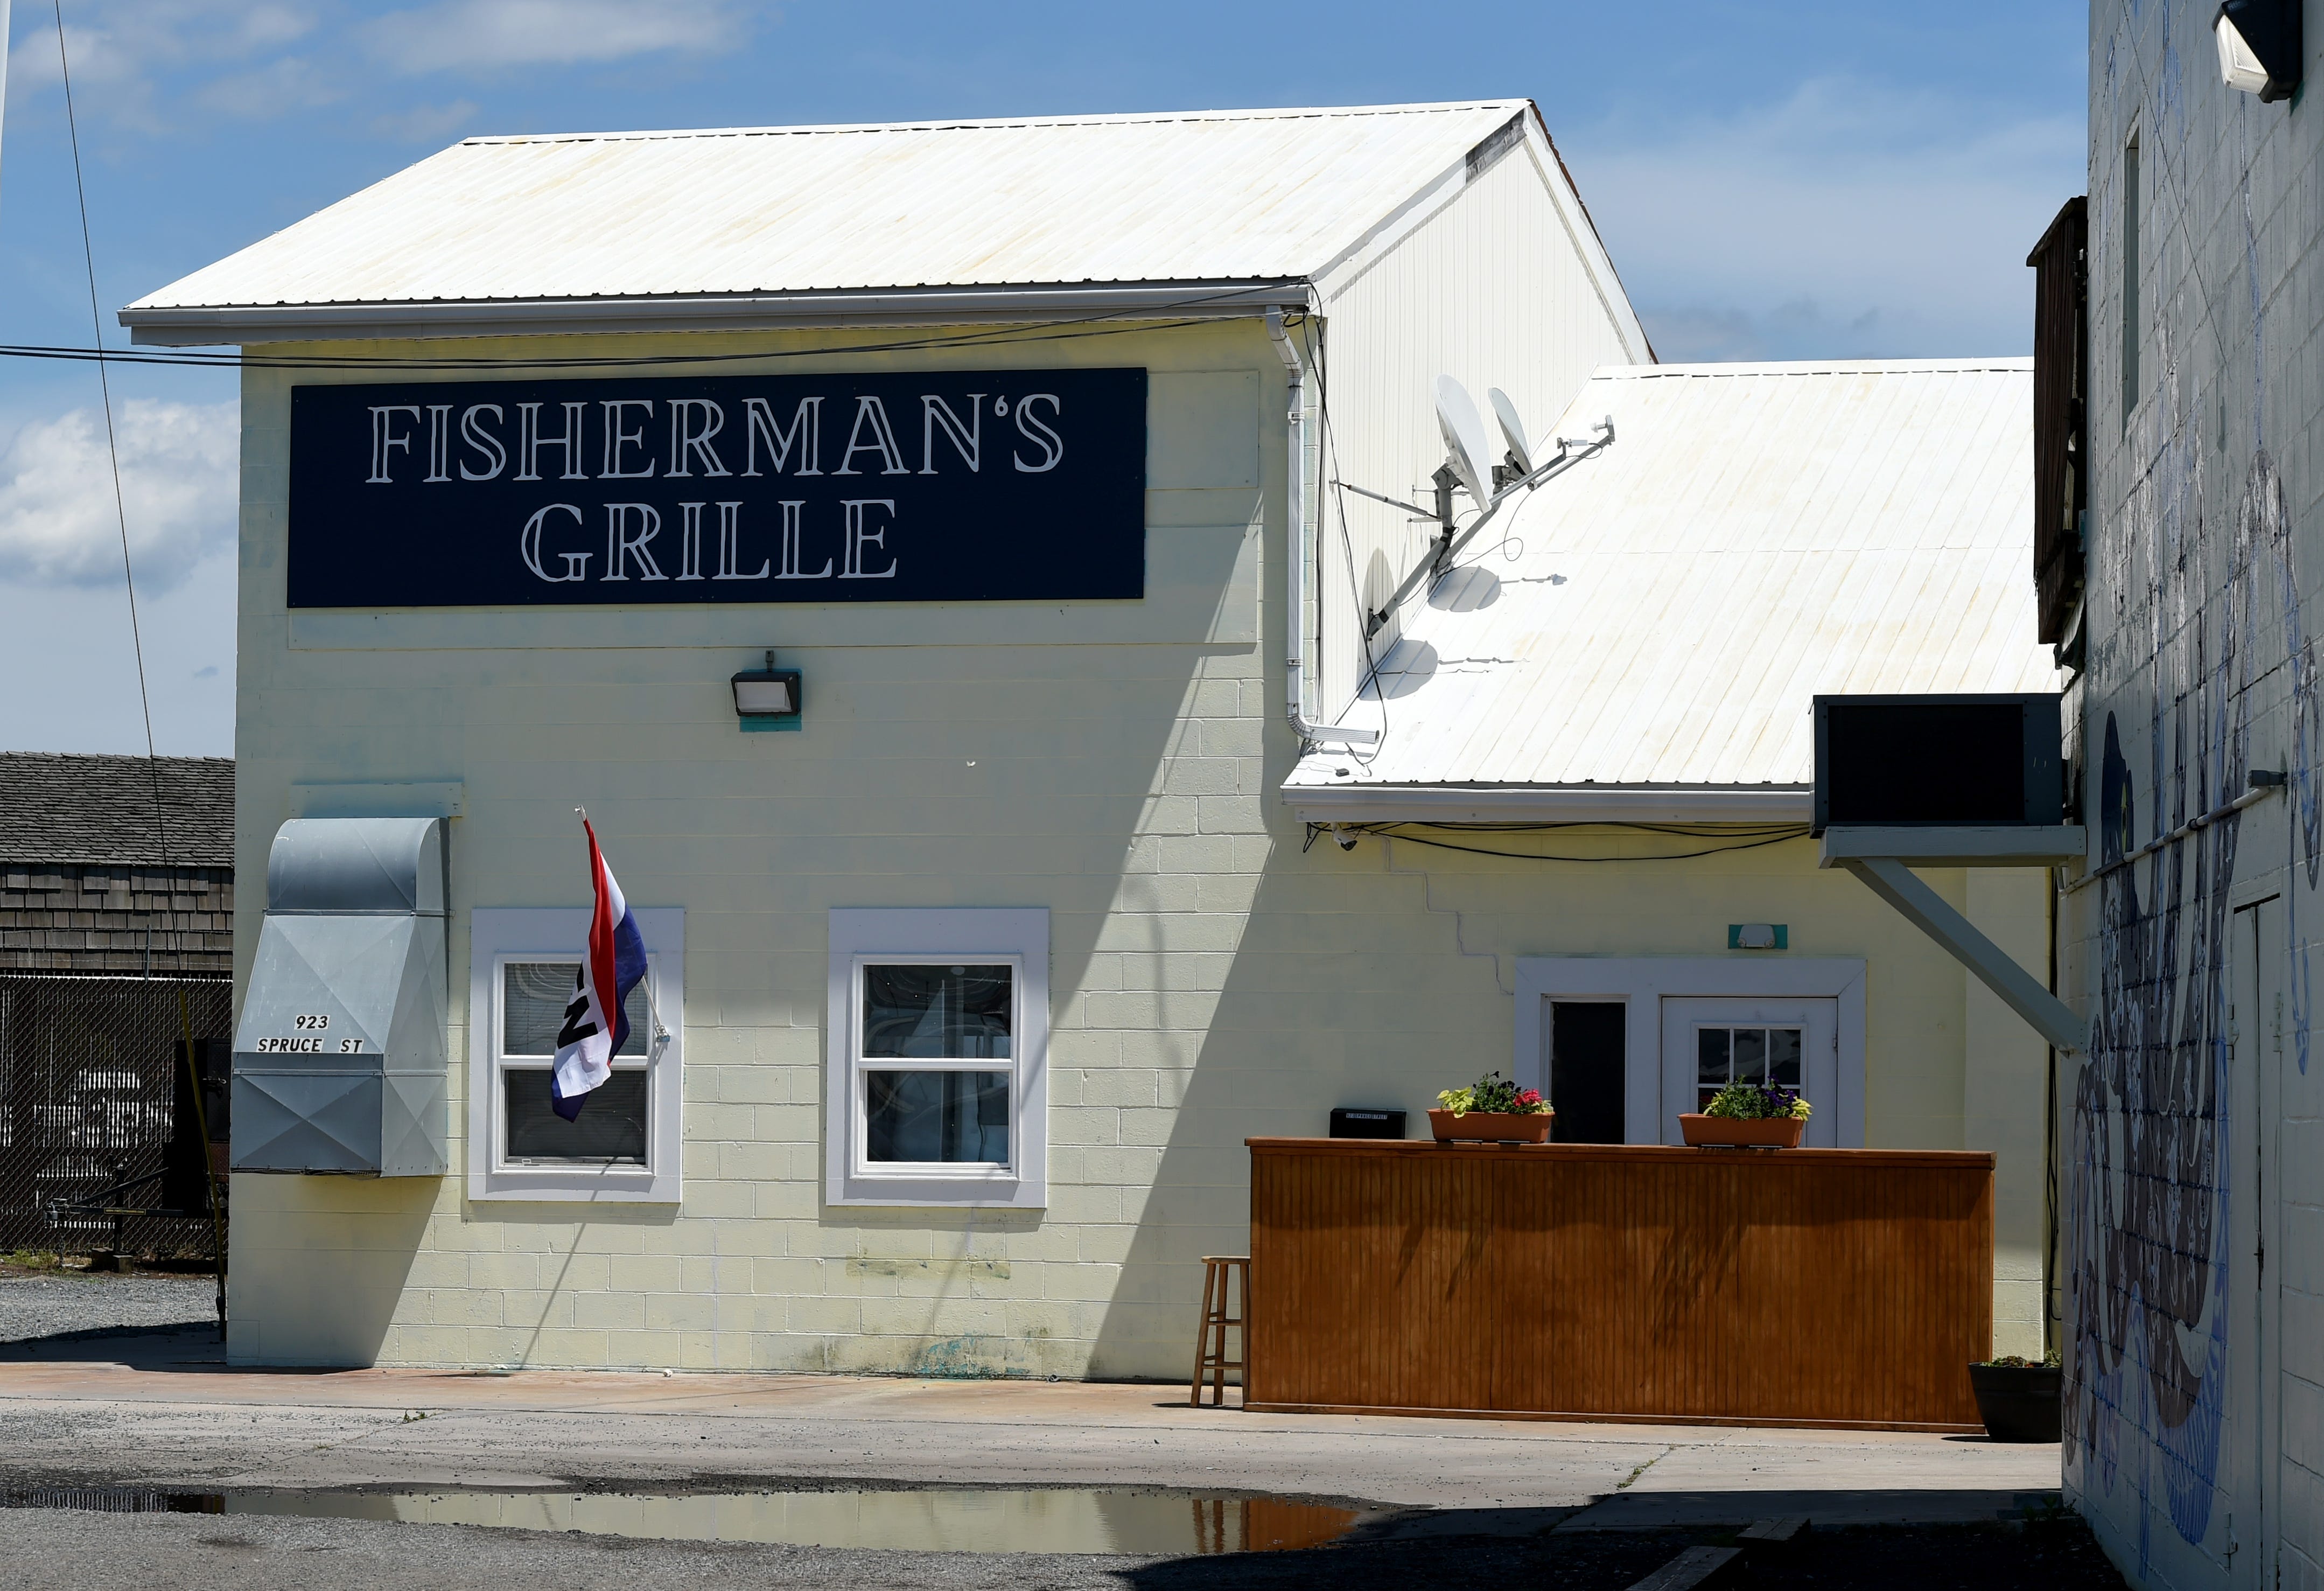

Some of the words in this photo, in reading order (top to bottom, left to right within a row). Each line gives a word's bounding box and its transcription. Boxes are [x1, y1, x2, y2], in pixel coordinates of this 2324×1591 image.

[365, 394, 1063, 483] FISHERMAN'S
[521, 499, 898, 582] GRILLE
[258, 1038, 323, 1052] SPRUCE
[341, 1039, 363, 1052] ST
[296, 1016, 328, 1029] 923
